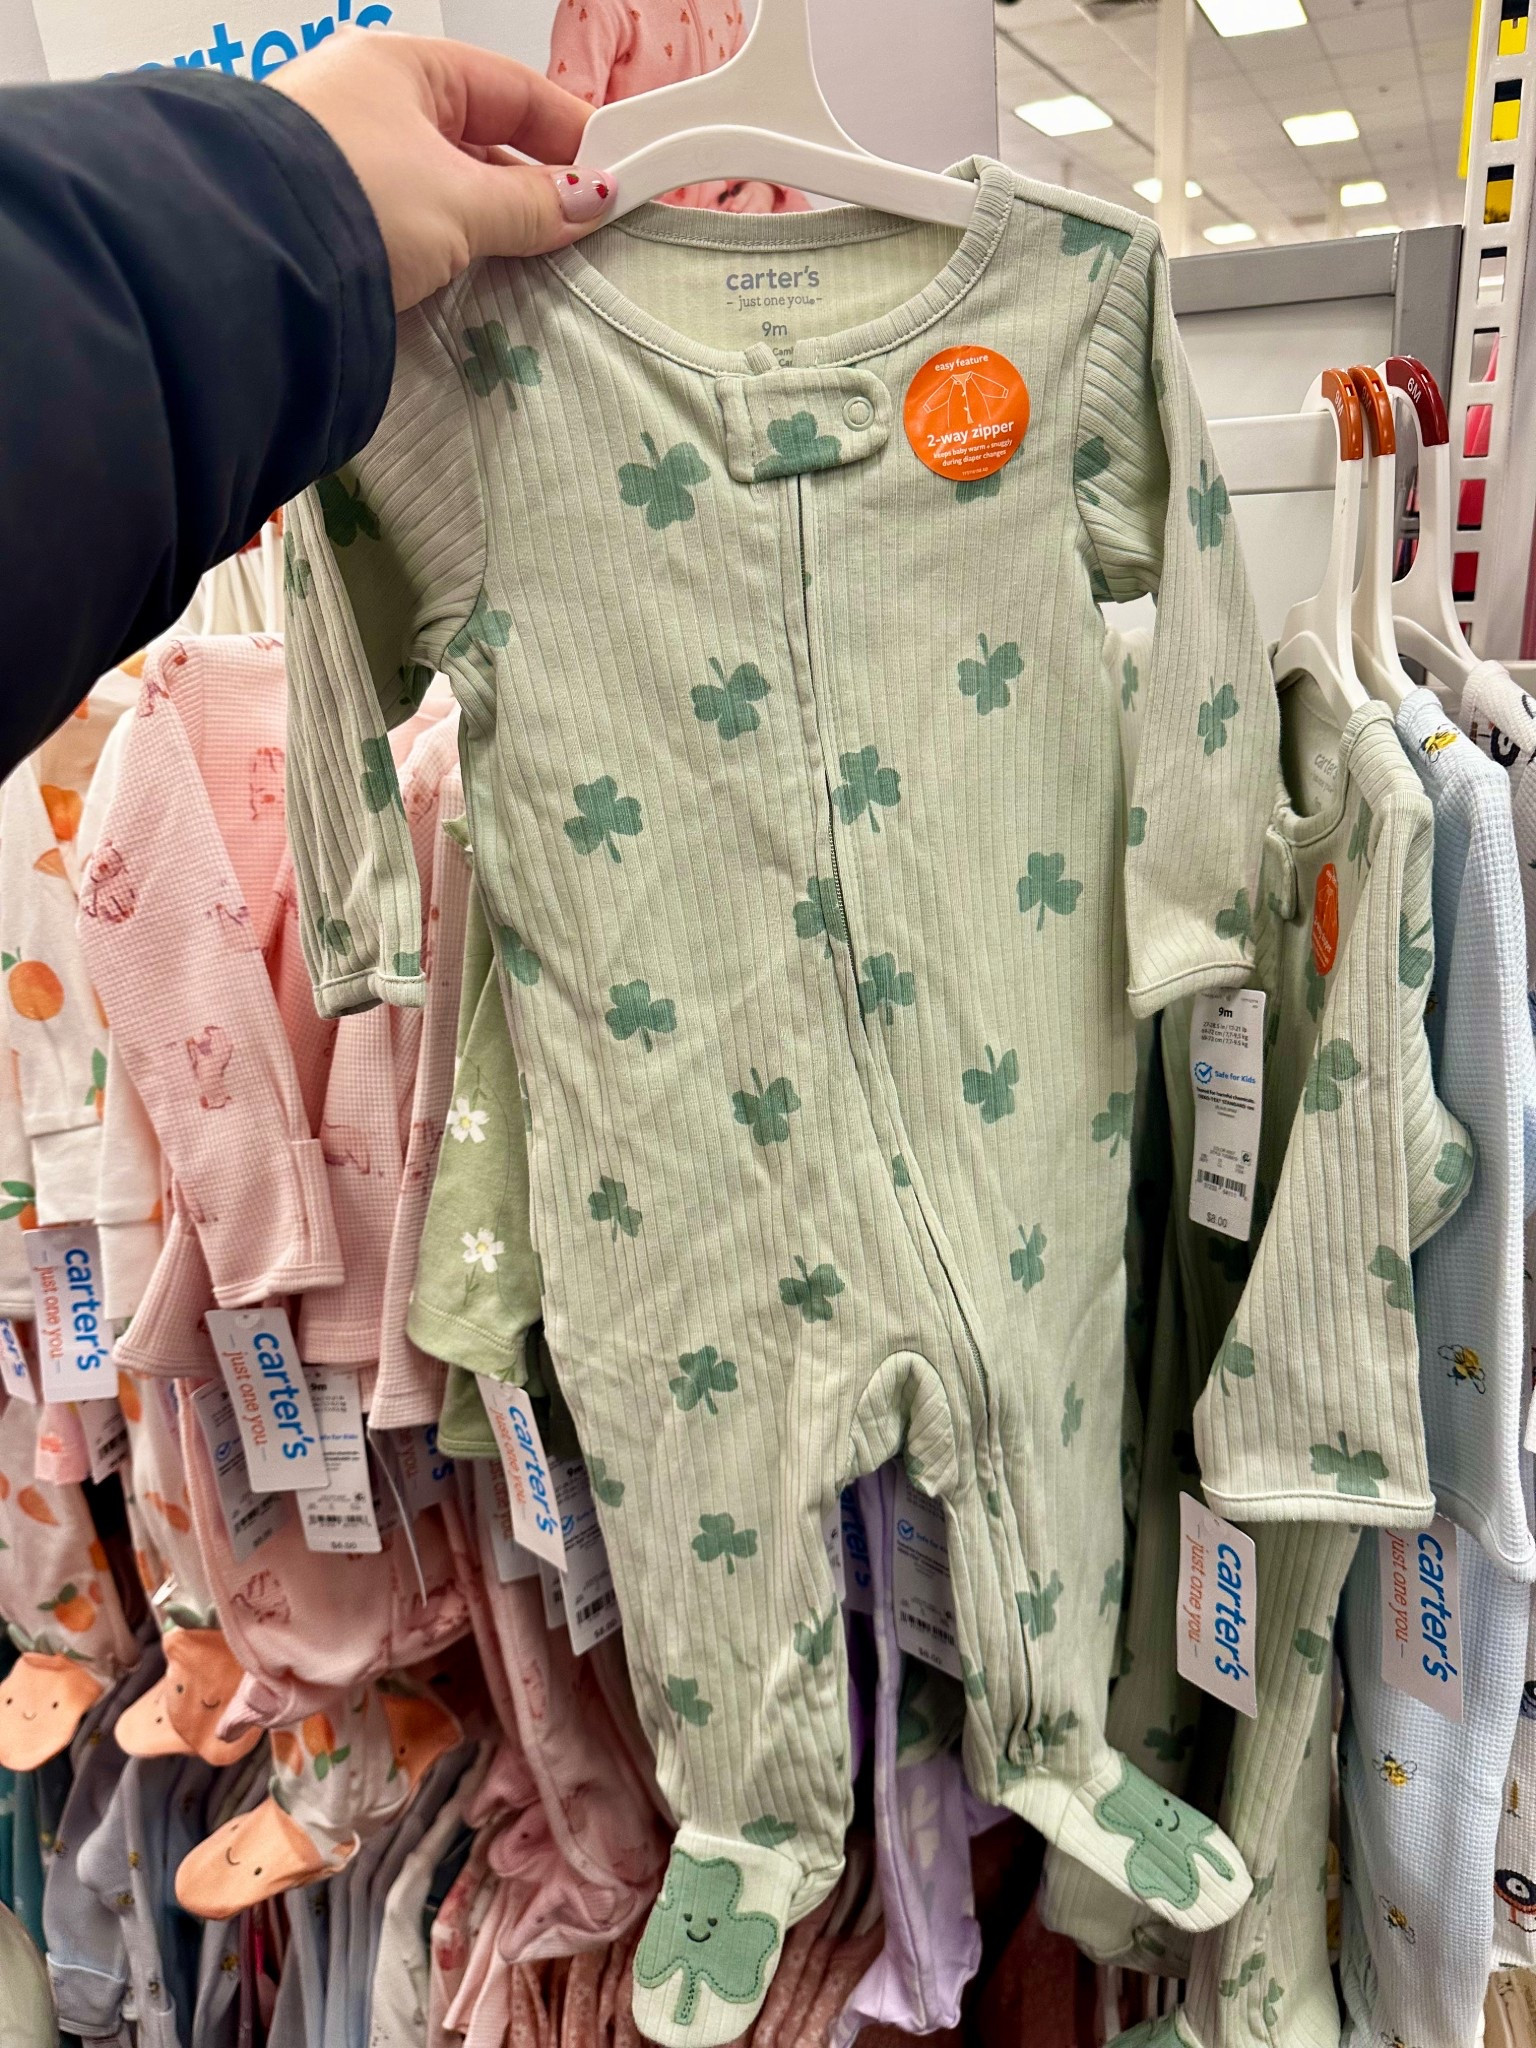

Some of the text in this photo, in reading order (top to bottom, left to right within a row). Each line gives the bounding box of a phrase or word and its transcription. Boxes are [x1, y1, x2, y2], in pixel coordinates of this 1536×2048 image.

[726, 265, 820, 291] carter's
[738, 295, 762, 312] just
[763, 296, 785, 307] one
[762, 321, 788, 337] 9m
[934, 354, 989, 372] easy feature
[1406, 377, 1422, 404] 6M
[926, 420, 1015, 448] 2-way zipper
[952, 447, 968, 455] baby
[968, 444, 986, 452] warm
[990, 438, 1013, 449] snuggly
[942, 449, 1007, 467] during diaper changes
[1218, 1006, 1233, 1019] 9m
[1214, 1070, 1256, 1084] Safe for Kids
[33, 1265, 64, 1360] just one you
[65, 1248, 110, 1371] carter's
[221, 1350, 251, 1380] just
[240, 1383, 260, 1412] one
[253, 1332, 315, 1460] carter's
[241, 1407, 268, 1446] you
[508, 1405, 559, 1536] carter's
[1183, 1534, 1210, 1643] just one you
[1385, 1528, 1410, 1644] just one you
[1214, 1543, 1249, 1681] carter's
[1417, 1532, 1458, 1683] carter's
